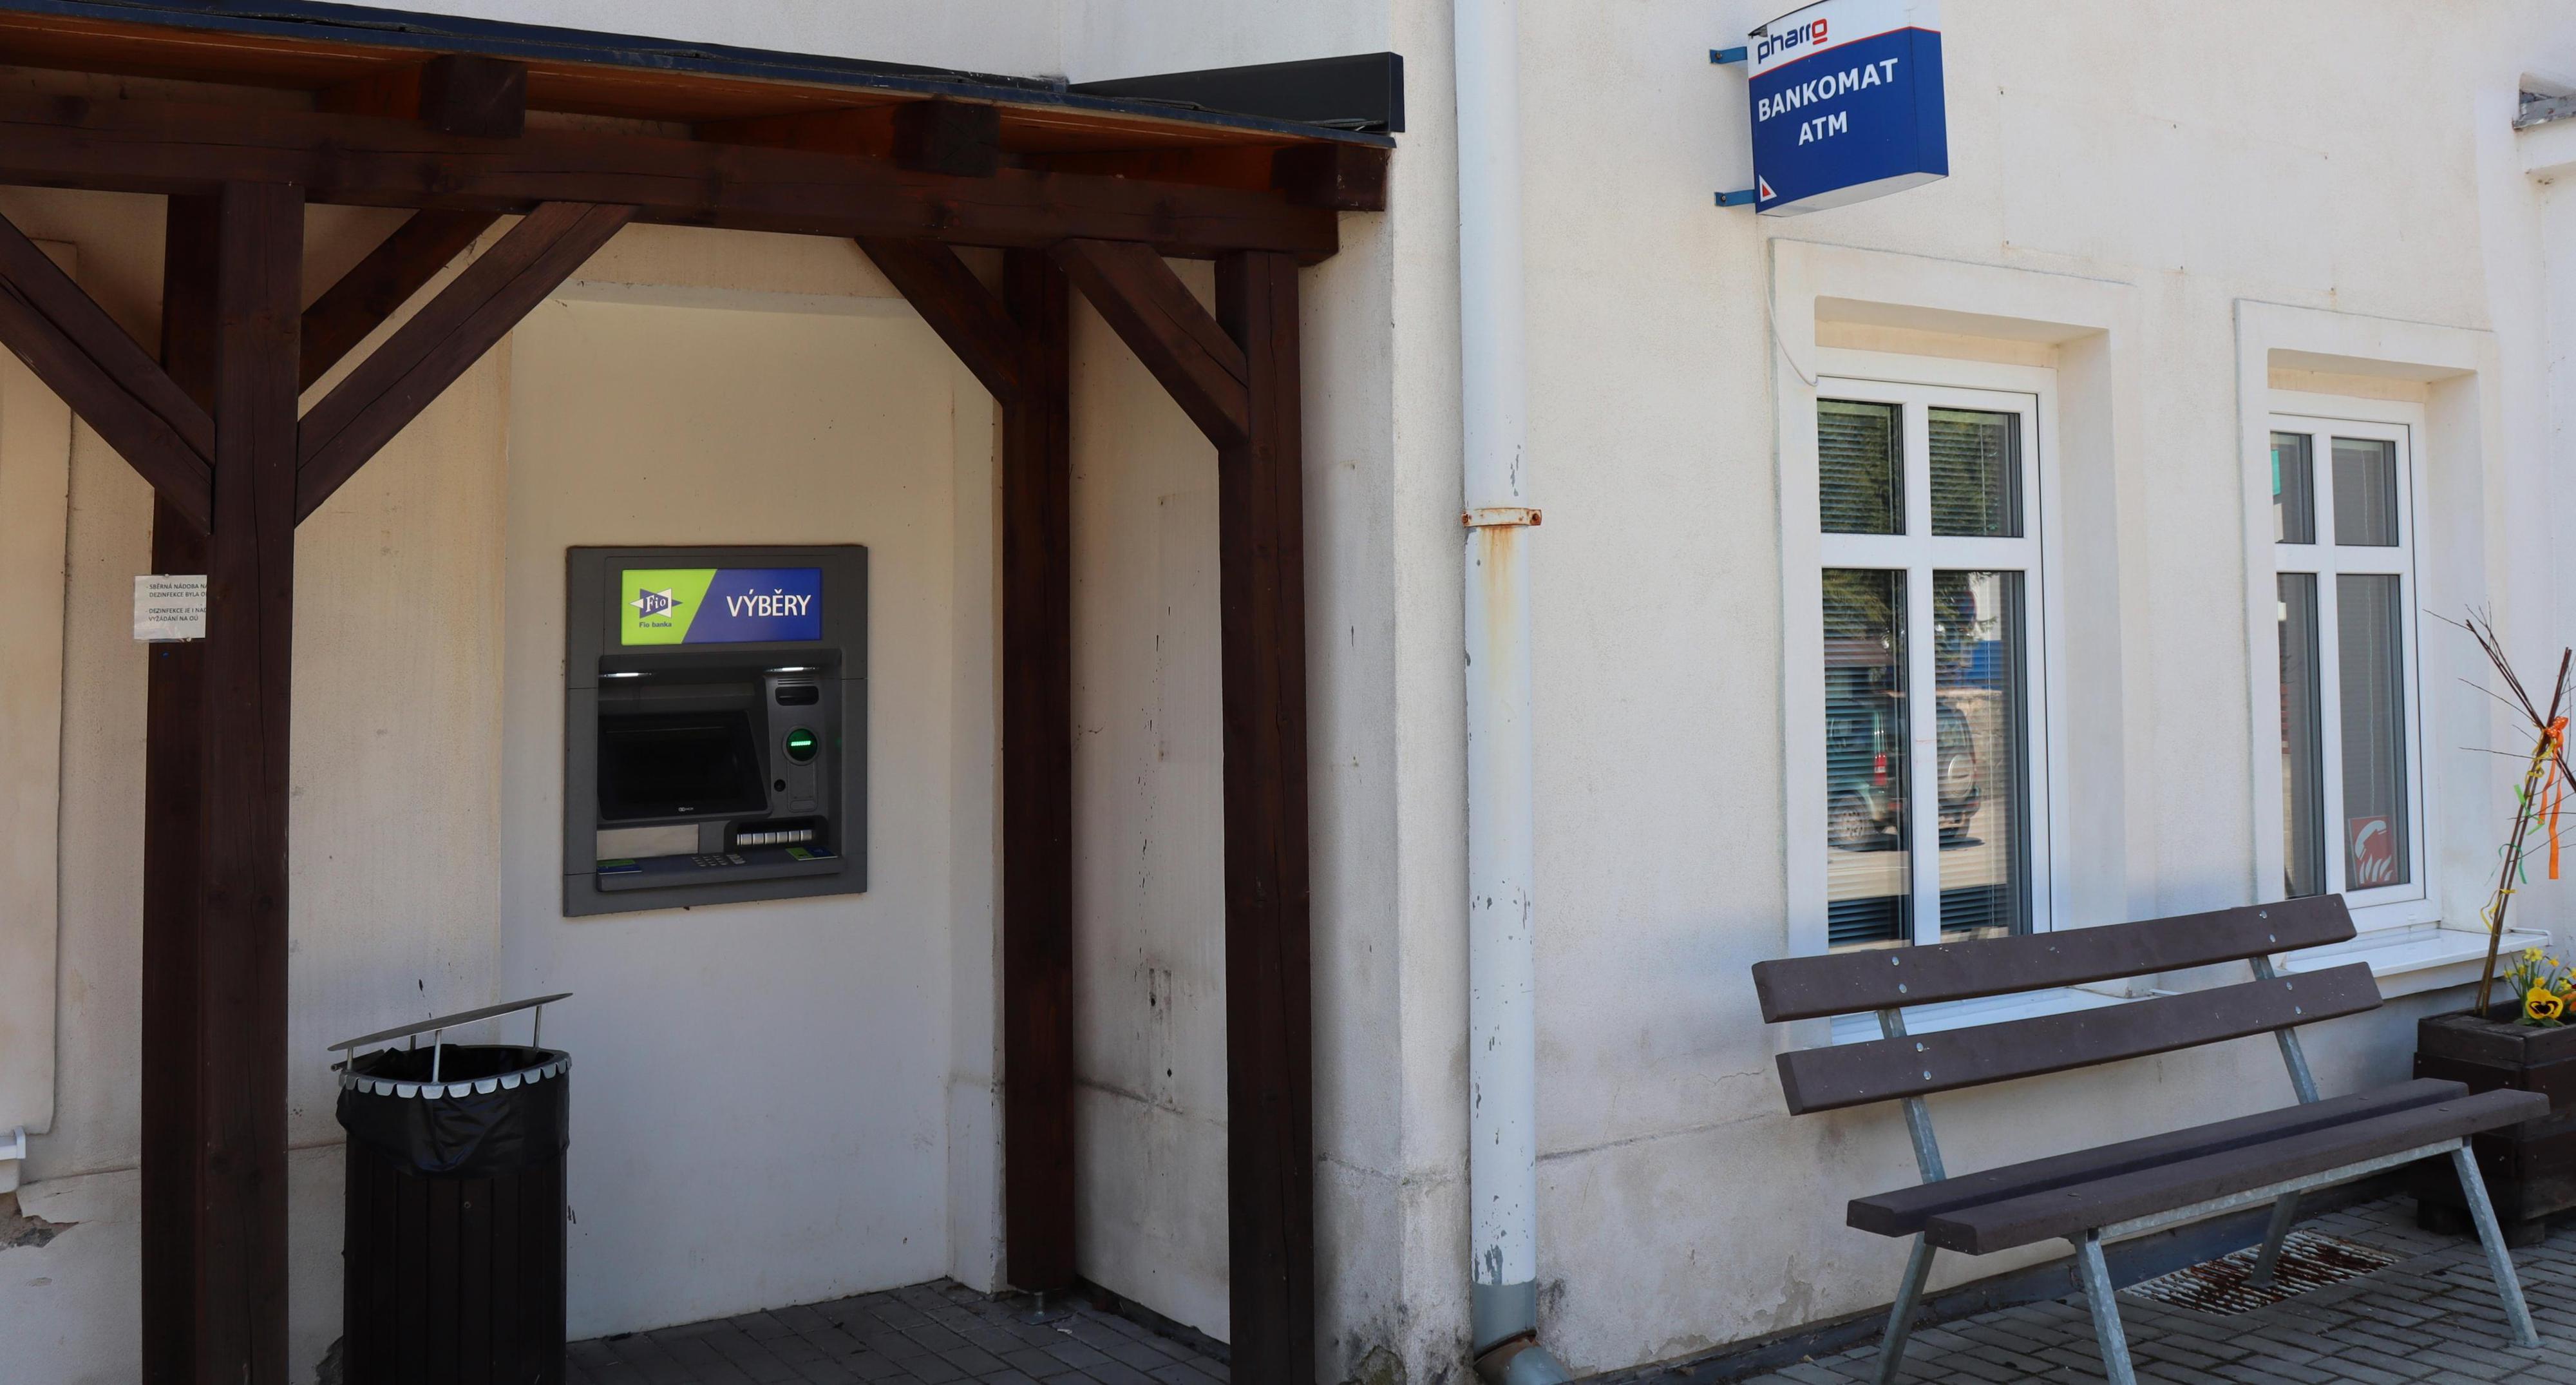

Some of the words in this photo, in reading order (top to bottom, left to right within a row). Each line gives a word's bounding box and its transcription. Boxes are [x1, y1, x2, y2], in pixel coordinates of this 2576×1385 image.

[1758, 57, 1898, 122] BANKOMAT
[1798, 111, 1848, 146] ATM
[645, 595, 667, 613] Fio
[726, 588, 811, 617] VÝBĚRY
